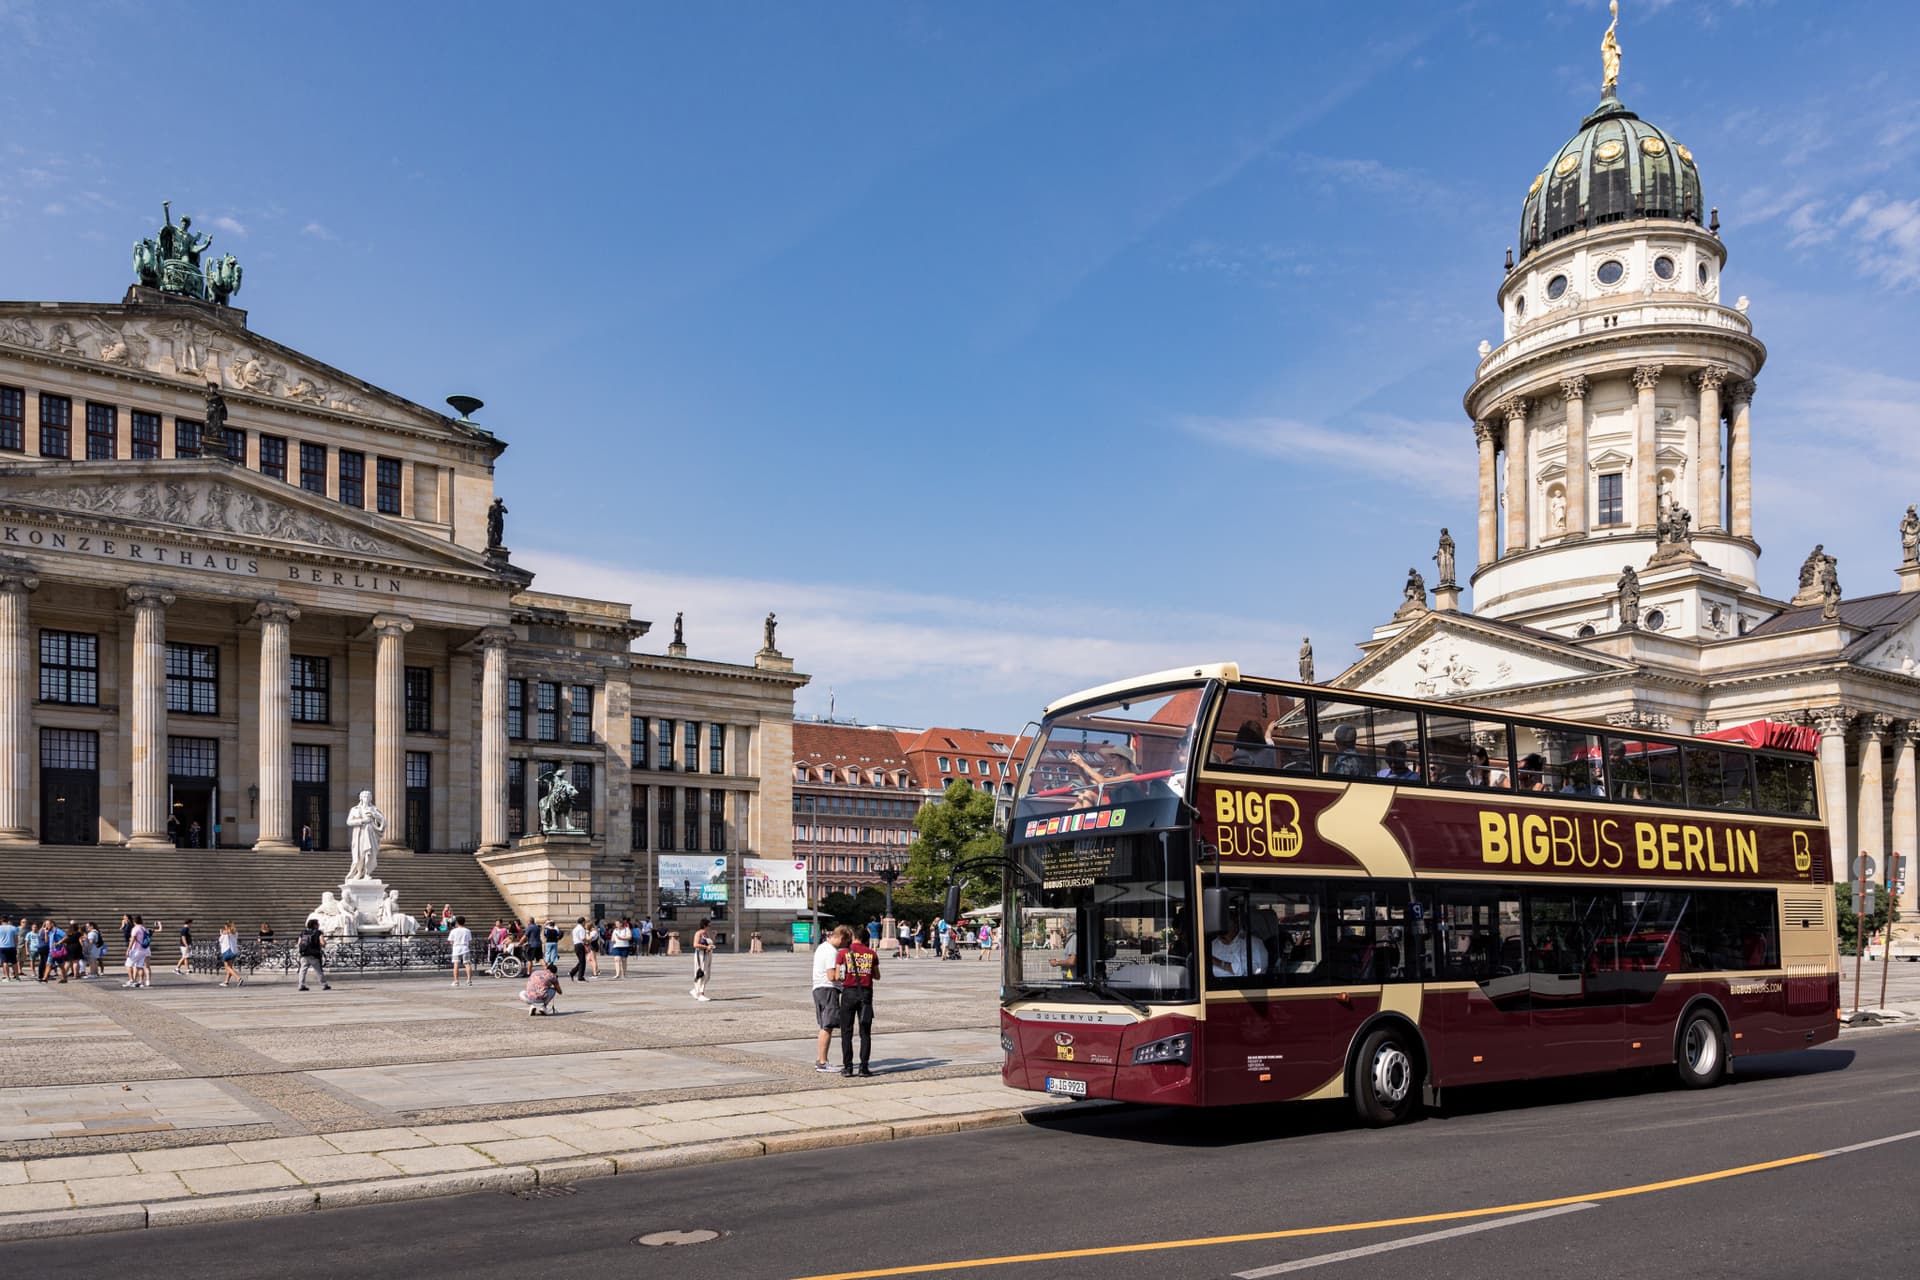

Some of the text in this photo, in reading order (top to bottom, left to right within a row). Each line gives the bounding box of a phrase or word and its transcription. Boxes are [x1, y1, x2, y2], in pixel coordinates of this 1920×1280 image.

[4, 526, 401, 593] KONZERTHAUS BERLIN
[1215, 789, 1264, 825] BIG
[1217, 825, 1267, 857] BUS
[1635, 822, 1759, 874] BERLIN
[1042, 877, 1095, 890] BIGBUSTOURS.COM
[1730, 983, 1783, 995] BIGBUSTOURS.COM
